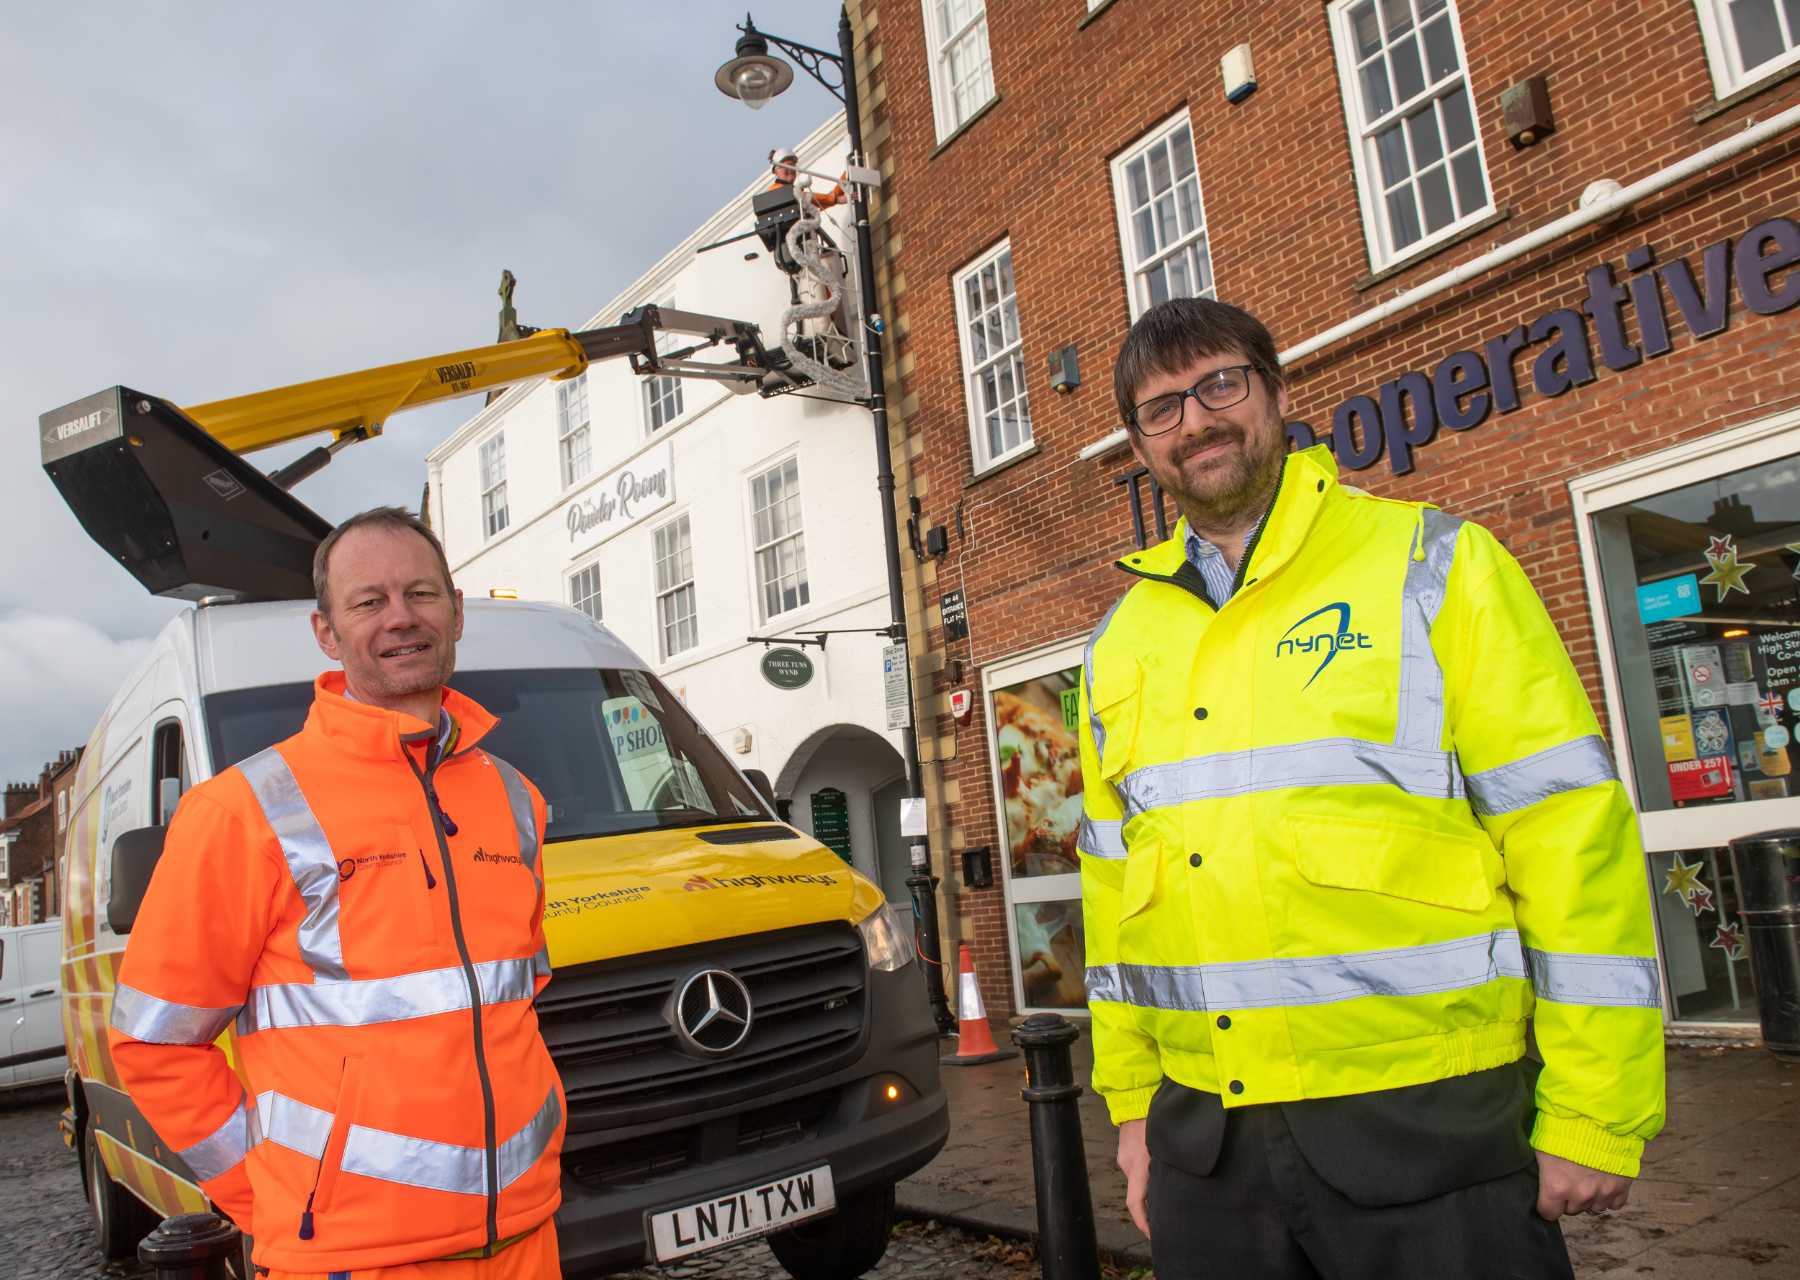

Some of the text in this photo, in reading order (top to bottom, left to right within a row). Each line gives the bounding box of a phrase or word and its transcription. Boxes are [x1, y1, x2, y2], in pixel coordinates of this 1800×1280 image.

[1283, 217, 1800, 476] -operative
[436, 361, 476, 384] VERSALIFT
[57, 411, 102, 440] VERSALIFT
[616, 468, 666, 519] Rooms
[944, 615, 955, 625] FLAT
[1760, 630, 1800, 643] Welcom
[1276, 632, 1372, 657] nynet
[1758, 640, 1800, 654] High Str
[1777, 650, 1800, 661] Co-o
[768, 660, 790, 668] THREE
[1767, 666, 1797, 677] Open
[1767, 678, 1790, 688] 6am
[1064, 693, 1080, 727] FA
[1670, 757, 1722, 774] UNDER 25?
[356, 856, 378, 865] North
[484, 853, 522, 866] highway
[716, 874, 838, 888] highways
[568, 886, 651, 903] Yorkshire
[583, 894, 645, 910] Council
[671, 1174, 816, 1248] LN71 TXW
